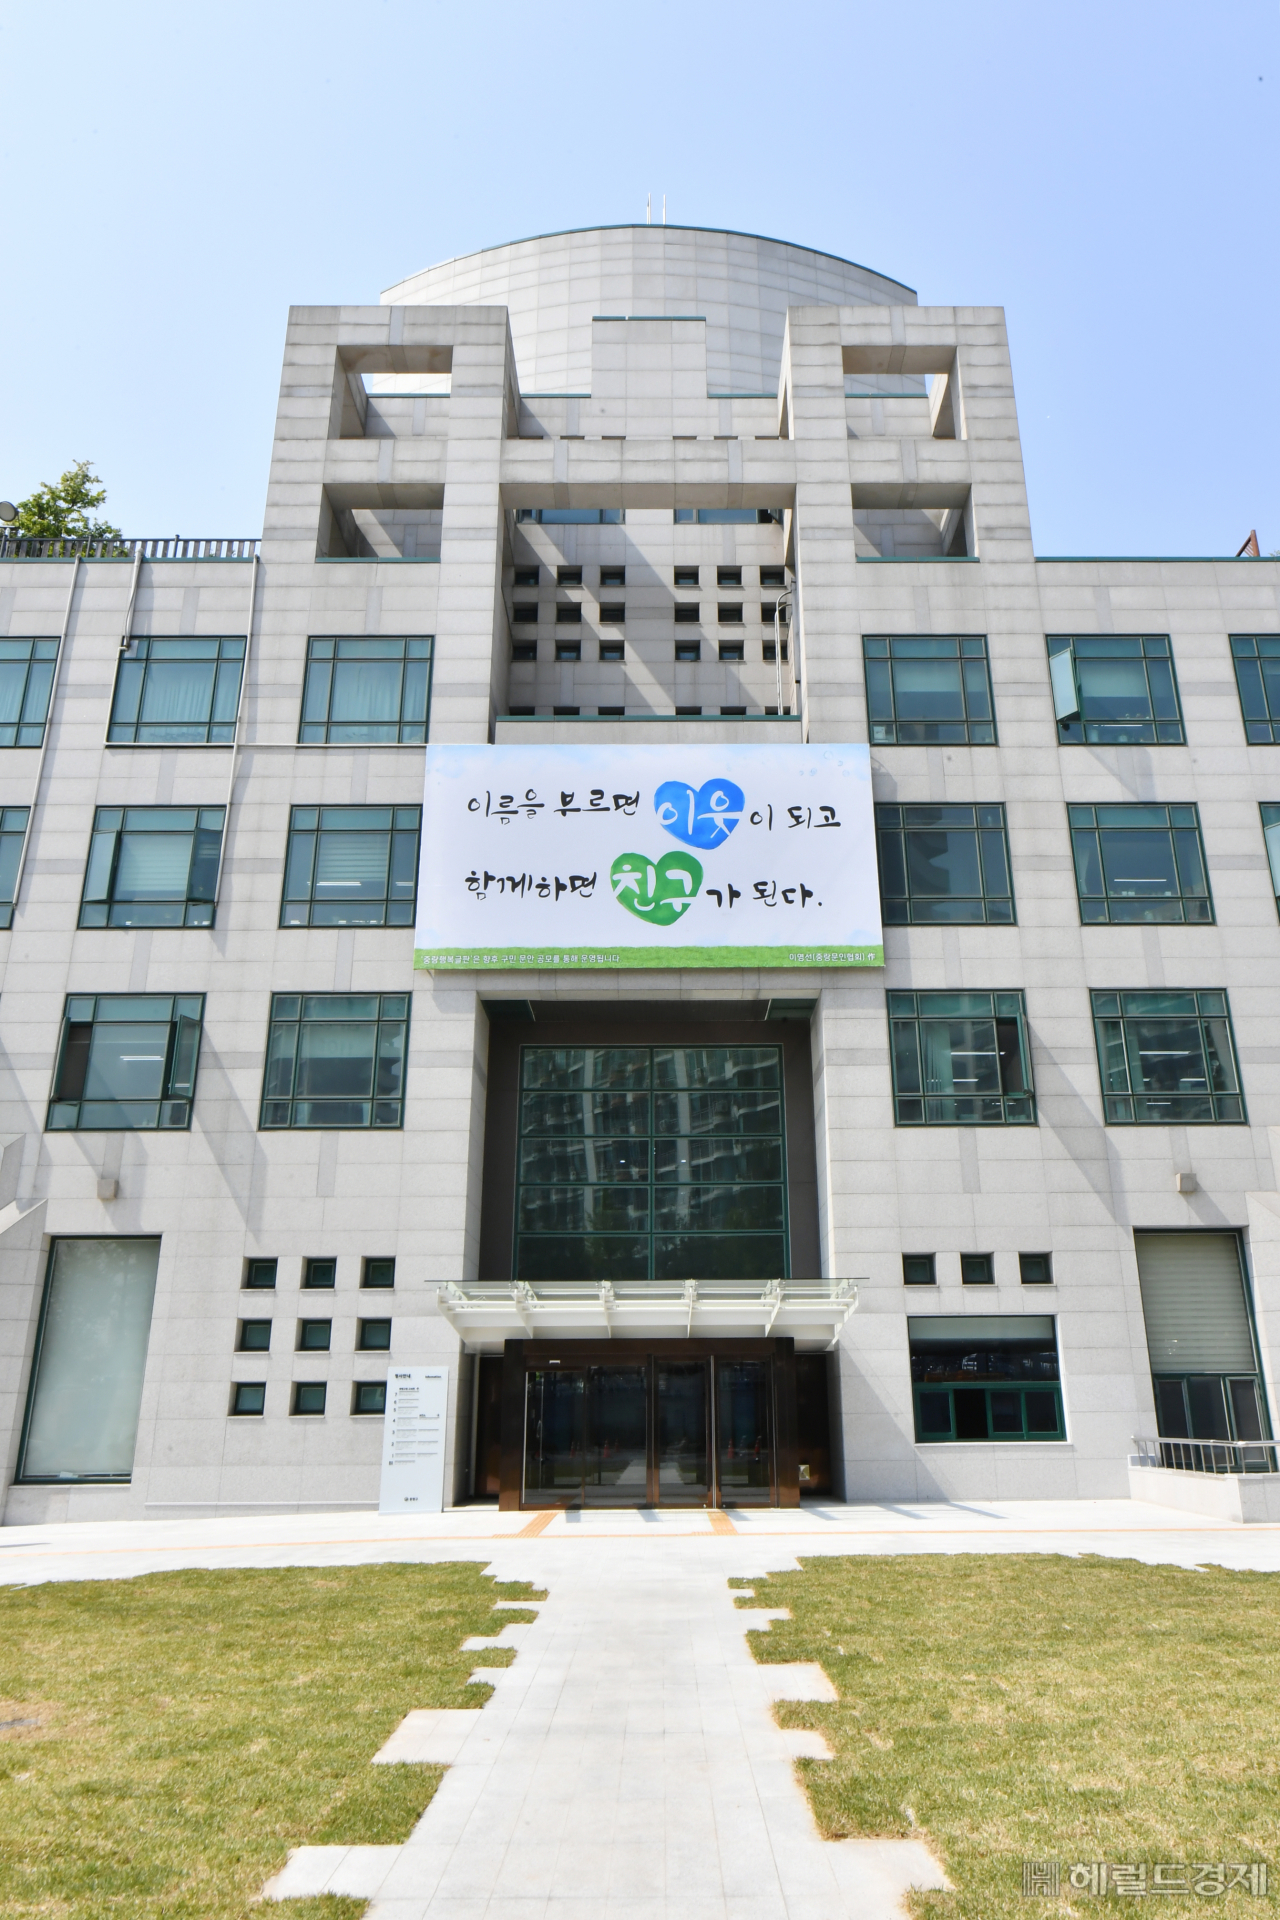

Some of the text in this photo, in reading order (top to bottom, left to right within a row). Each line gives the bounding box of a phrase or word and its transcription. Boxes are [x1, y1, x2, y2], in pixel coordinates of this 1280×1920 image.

[467, 789, 545, 825] 이름을
[553, 789, 640, 817] 부르면
[787, 805, 841, 829] 되고
[464, 870, 598, 902] 함께하면
[752, 880, 823, 908] 된다.
[483, 954, 498, 964] 향후
[501, 954, 517, 964] 구민
[519, 954, 535, 964] 문안
[537, 954, 560, 964] 공모를
[562, 954, 579, 963] 통해
